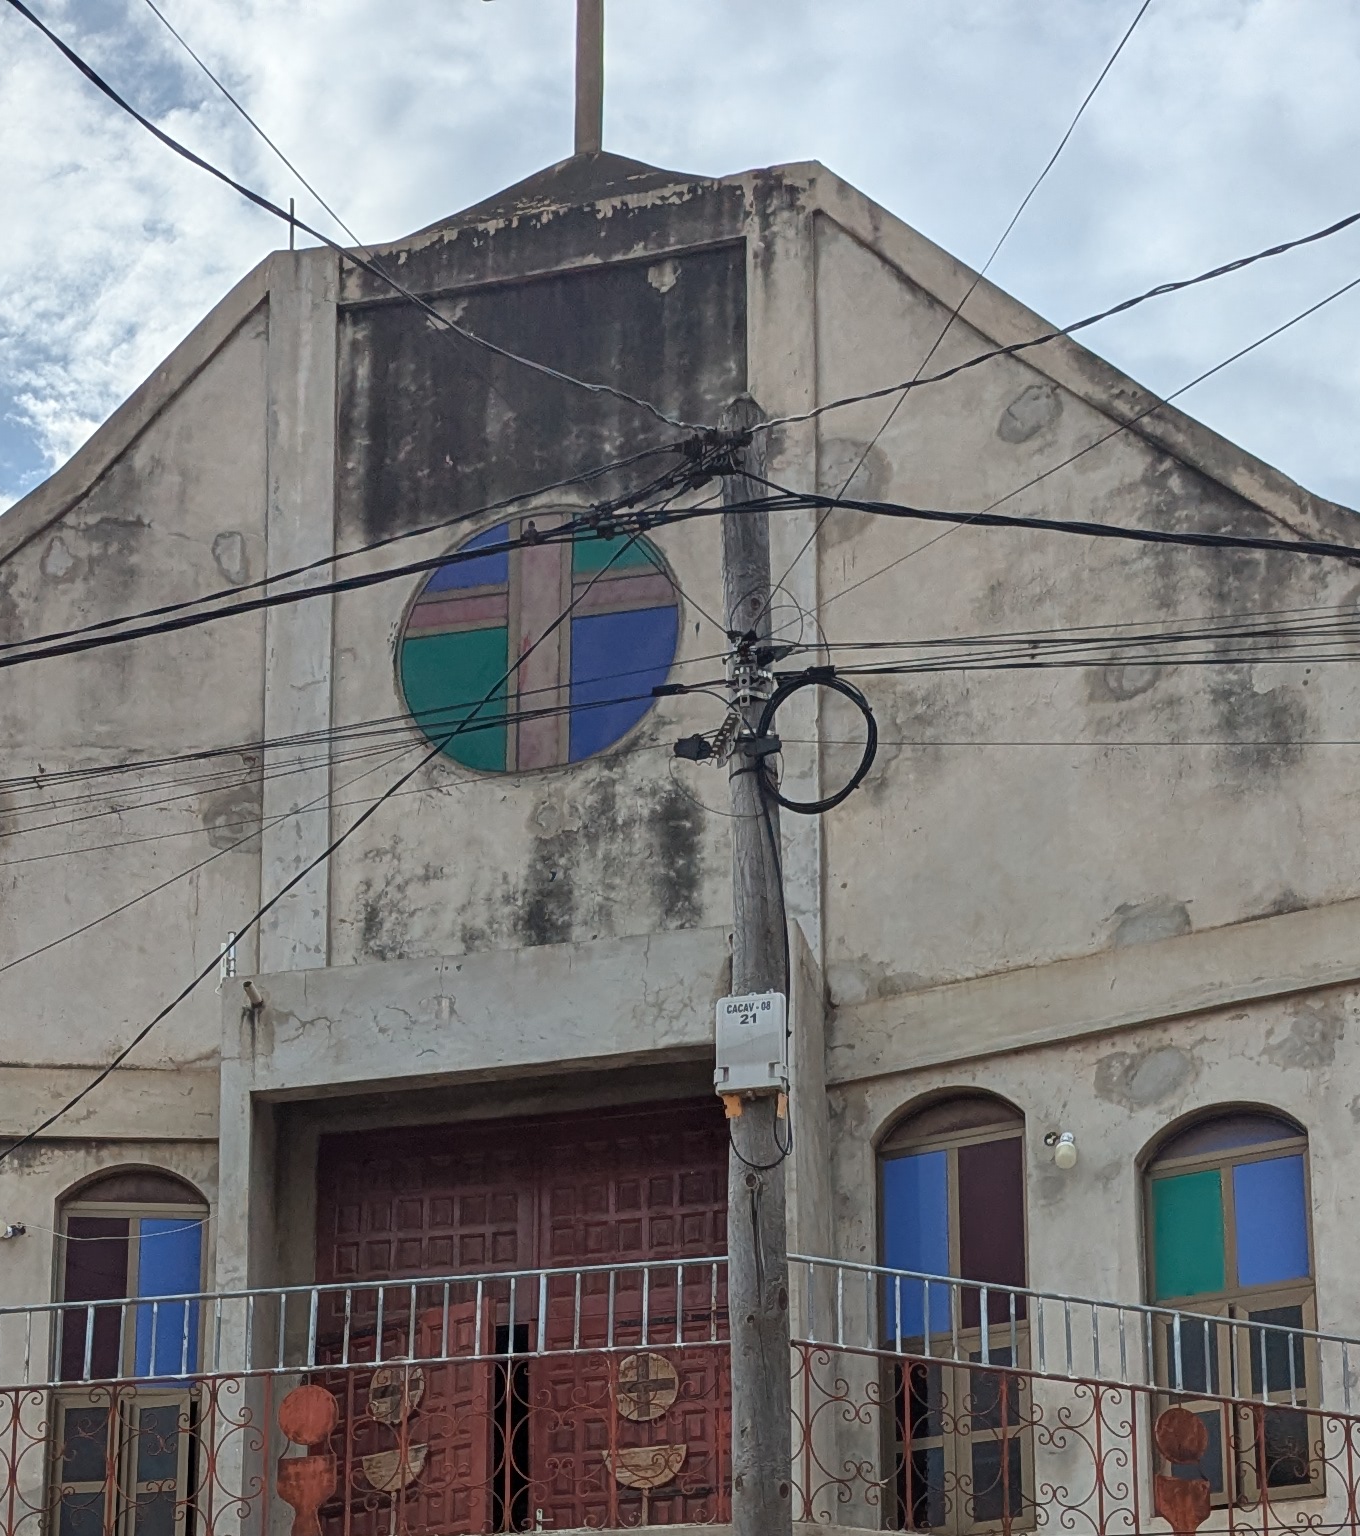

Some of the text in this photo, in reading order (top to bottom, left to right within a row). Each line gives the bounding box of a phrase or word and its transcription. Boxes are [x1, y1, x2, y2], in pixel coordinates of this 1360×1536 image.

[726, 1002, 755, 1014] CACAV
[760, 1000, 771, 1011] 08
[739, 1013, 757, 1025] 21
